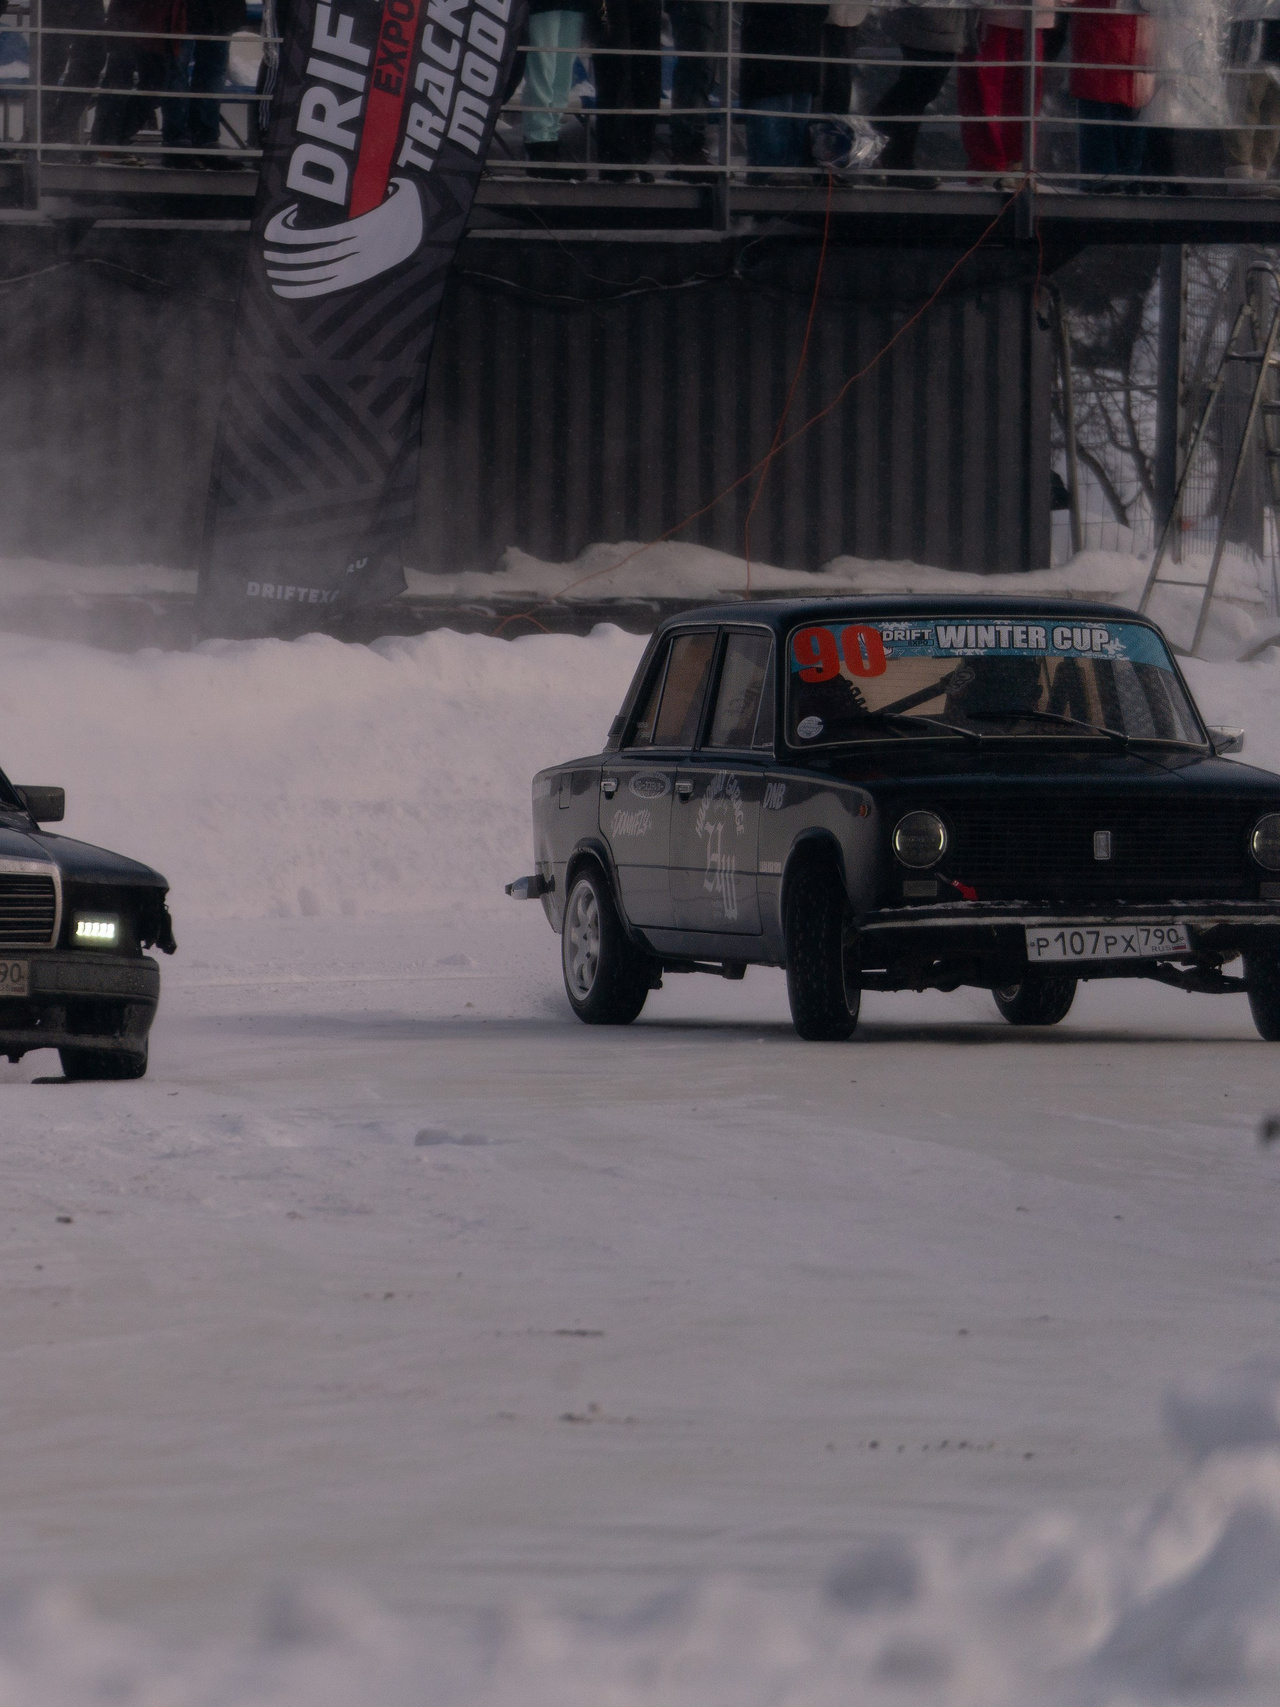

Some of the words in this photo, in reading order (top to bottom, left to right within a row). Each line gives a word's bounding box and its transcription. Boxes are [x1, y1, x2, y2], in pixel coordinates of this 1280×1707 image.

[372, 0, 417, 96] EXPO
[286, 0, 374, 206] DRIF
[396, 0, 470, 172] TRACK
[793, 625, 888, 684] 90
[882, 629, 933, 642] DRIFT
[935, 624, 1051, 651] WINTER
[1053, 626, 1110, 653] CUP
[1139, 928, 1180, 946] 790
[1151, 944, 1171, 953] RUS
